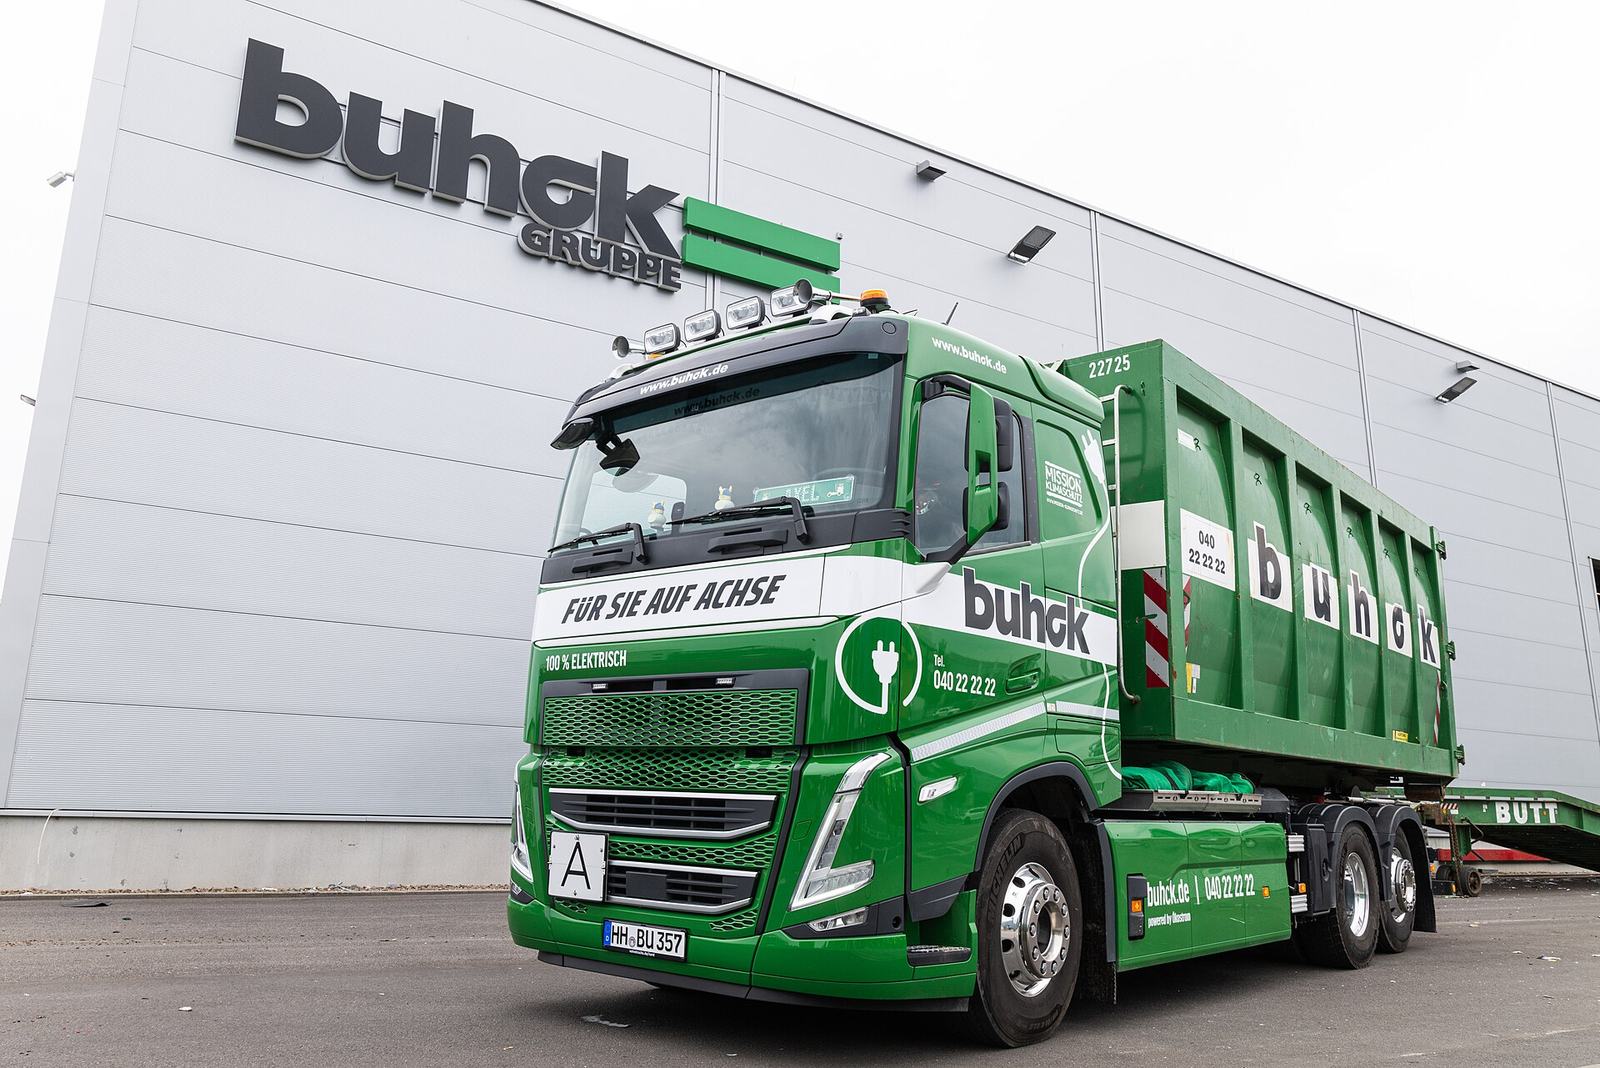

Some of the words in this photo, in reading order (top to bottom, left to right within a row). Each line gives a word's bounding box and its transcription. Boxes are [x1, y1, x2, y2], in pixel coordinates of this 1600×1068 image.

[234, 38, 681, 262] buhck
[518, 222, 682, 291] GRUPPE
[932, 337, 1007, 374] www.buhck.de
[1088, 354, 1131, 379] 22725
[639, 363, 729, 395] www.buhck.de
[1045, 465, 1082, 493] MISSION
[1045, 479, 1083, 504] KLIMASCHUTZ
[1198, 530, 1215, 549] 040
[1189, 548, 1201, 565] 22
[1202, 552, 1214, 570] 22
[1215, 556, 1226, 574] 22
[561, 594, 607, 624] FÜR
[605, 590, 647, 620] SIE
[644, 584, 698, 615] AUF
[693, 574, 787, 611] ACHSE
[963, 567, 1090, 655] buhck
[545, 655, 560, 671] 100
[571, 650, 627, 670] ELEKTRISCH
[933, 654, 945, 667] Tel.
[933, 670, 953, 690] 040
[955, 673, 968, 693] 22
[970, 675, 982, 695] 22
[984, 677, 996, 697] 22
[1495, 802, 1558, 824] BUTT
[560, 841, 591, 890] A
[1146, 878, 1190, 907] buhck.de
[1204, 876, 1221, 900] 040
[1222, 875, 1233, 899] 22
[1233, 874, 1244, 897] 22
[1244, 873, 1256, 896] 22
[612, 925, 628, 946] HH
[637, 929, 654, 949] BU
[657, 932, 683, 953] 357
